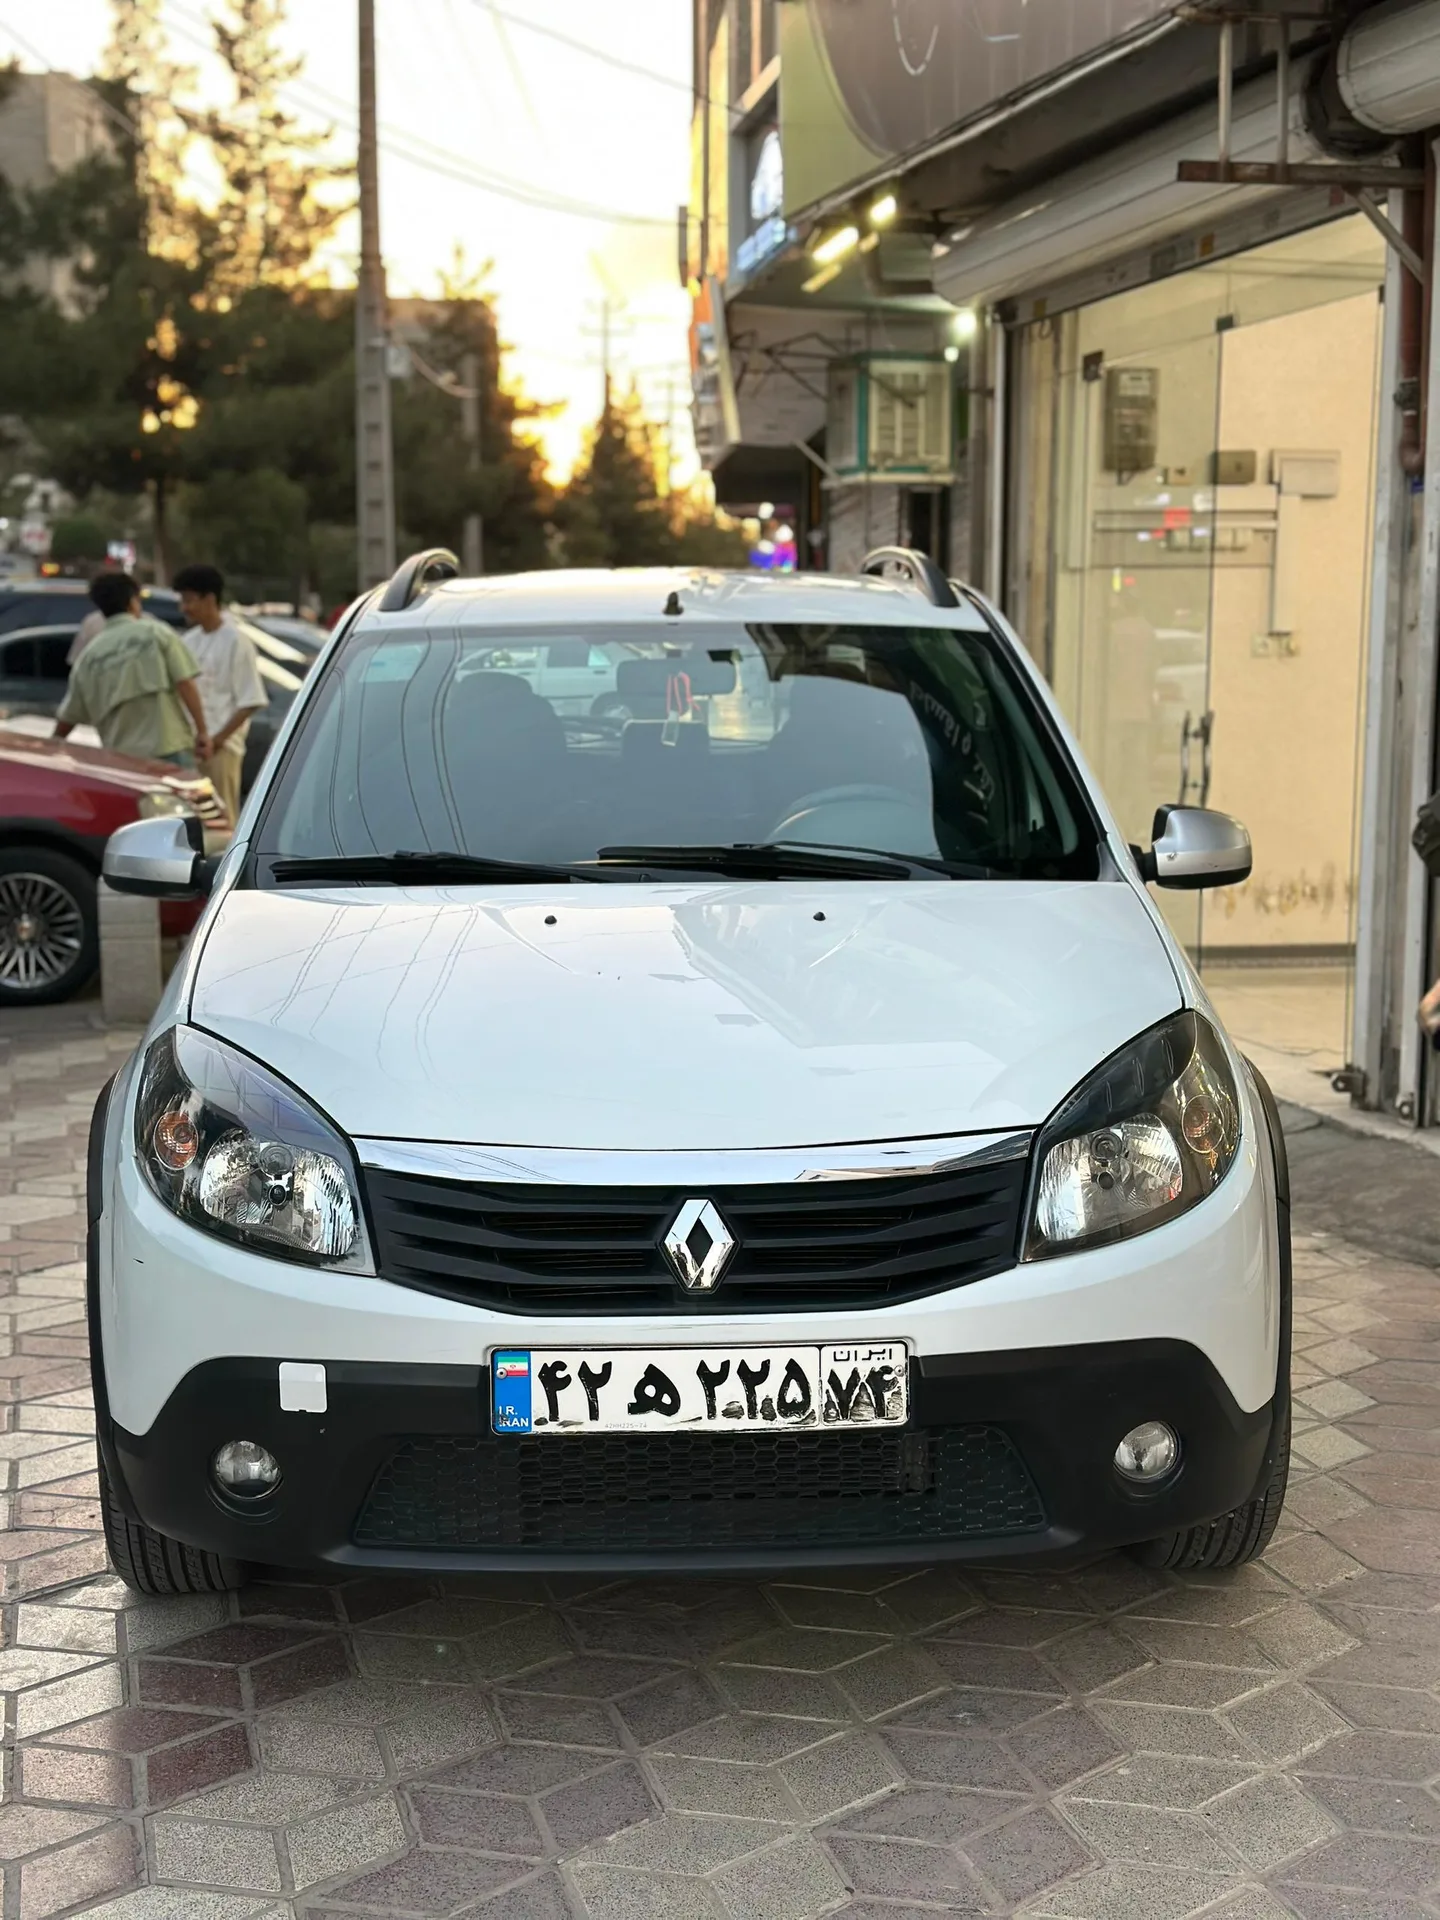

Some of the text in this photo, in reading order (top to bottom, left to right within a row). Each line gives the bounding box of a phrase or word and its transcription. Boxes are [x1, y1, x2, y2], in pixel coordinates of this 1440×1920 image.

[833, 1347, 893, 1362] ایران
[538, 1359, 613, 1422] ۴۲
[696, 1358, 813, 1420] ۲۲۵
